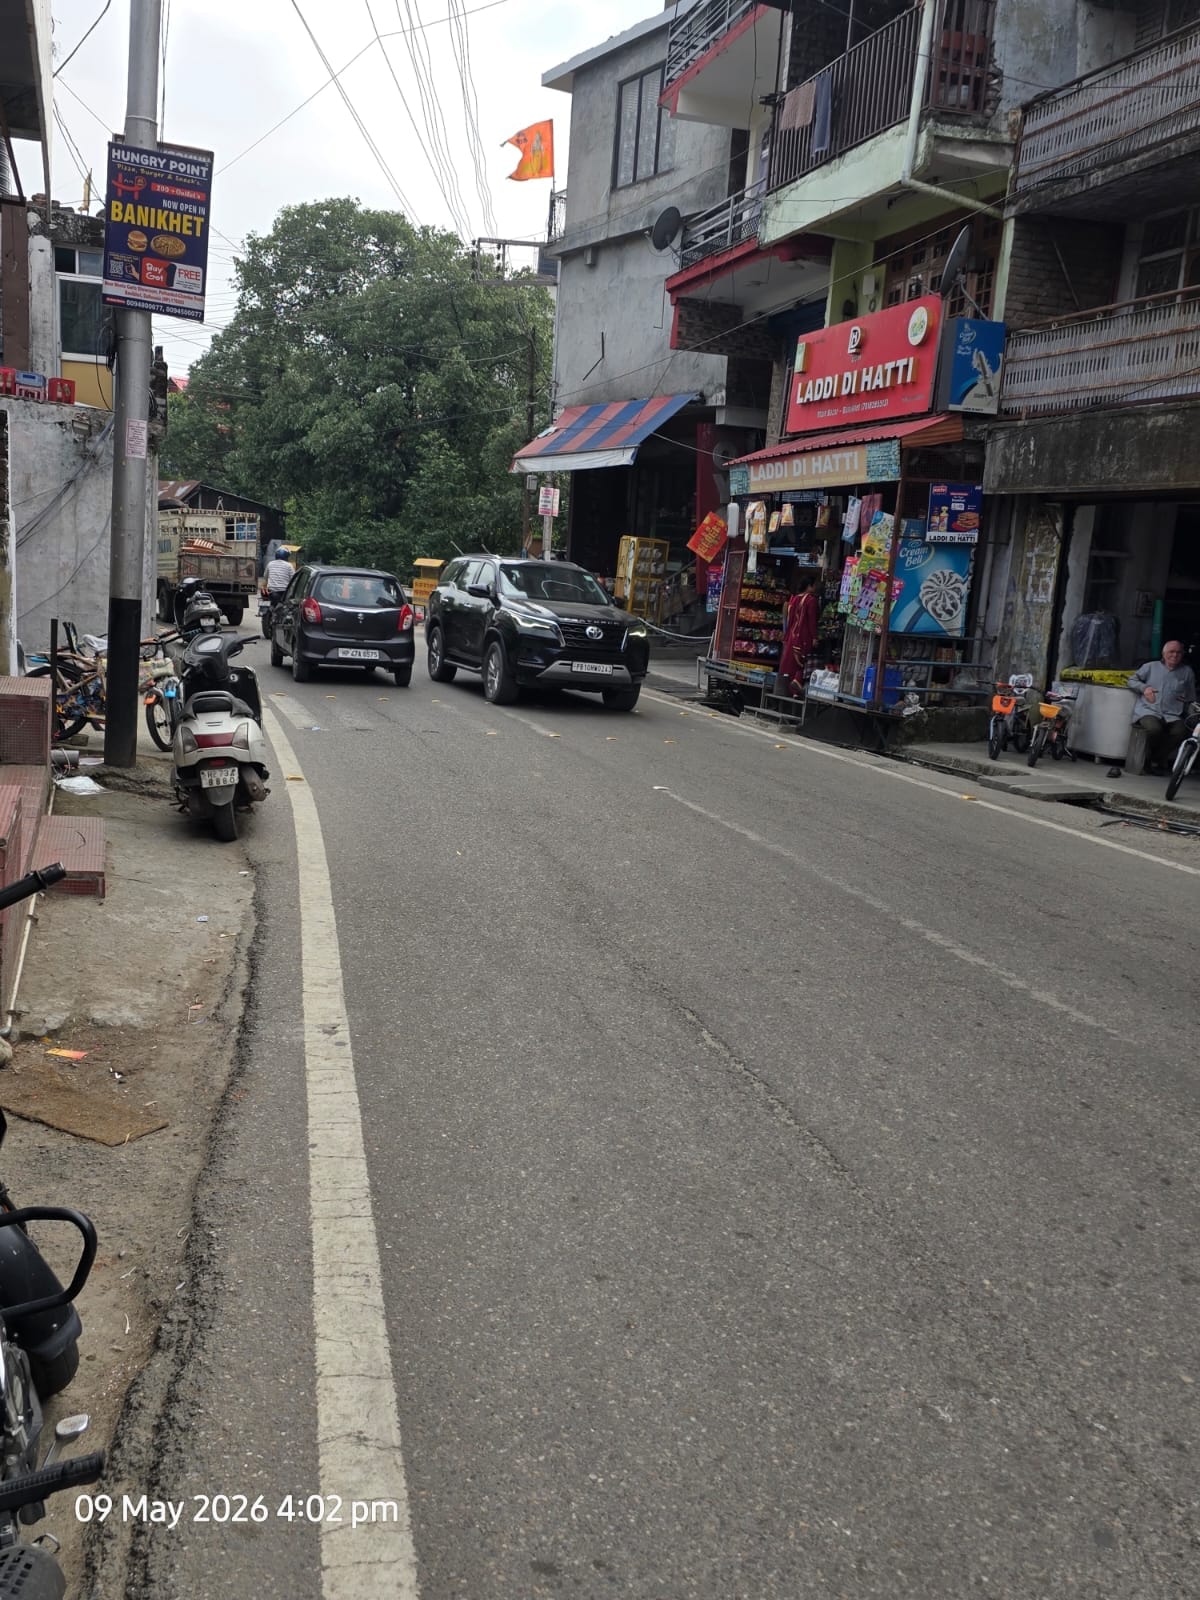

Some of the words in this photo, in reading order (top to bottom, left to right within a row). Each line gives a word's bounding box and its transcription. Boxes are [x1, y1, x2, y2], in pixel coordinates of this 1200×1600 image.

[112, 148, 166, 168] HUNGRY
[170, 160, 208, 178] POINT
[162, 199, 178, 211] NOW
[180, 201, 197, 214] OPEN
[198, 204, 206, 216] IN
[111, 200, 204, 237] BANIKHET
[146, 262, 164, 274] Buy
[178, 268, 201, 281] FREE
[796, 376, 838, 404] LADDI
[842, 371, 857, 395] DI
[860, 356, 914, 392] HATTI
[750, 462, 788, 482] LADDI
[792, 459, 806, 476] DI
[812, 452, 858, 475] HATTI
[900, 546, 929, 558] Cream
[905, 555, 923, 567] Bell
